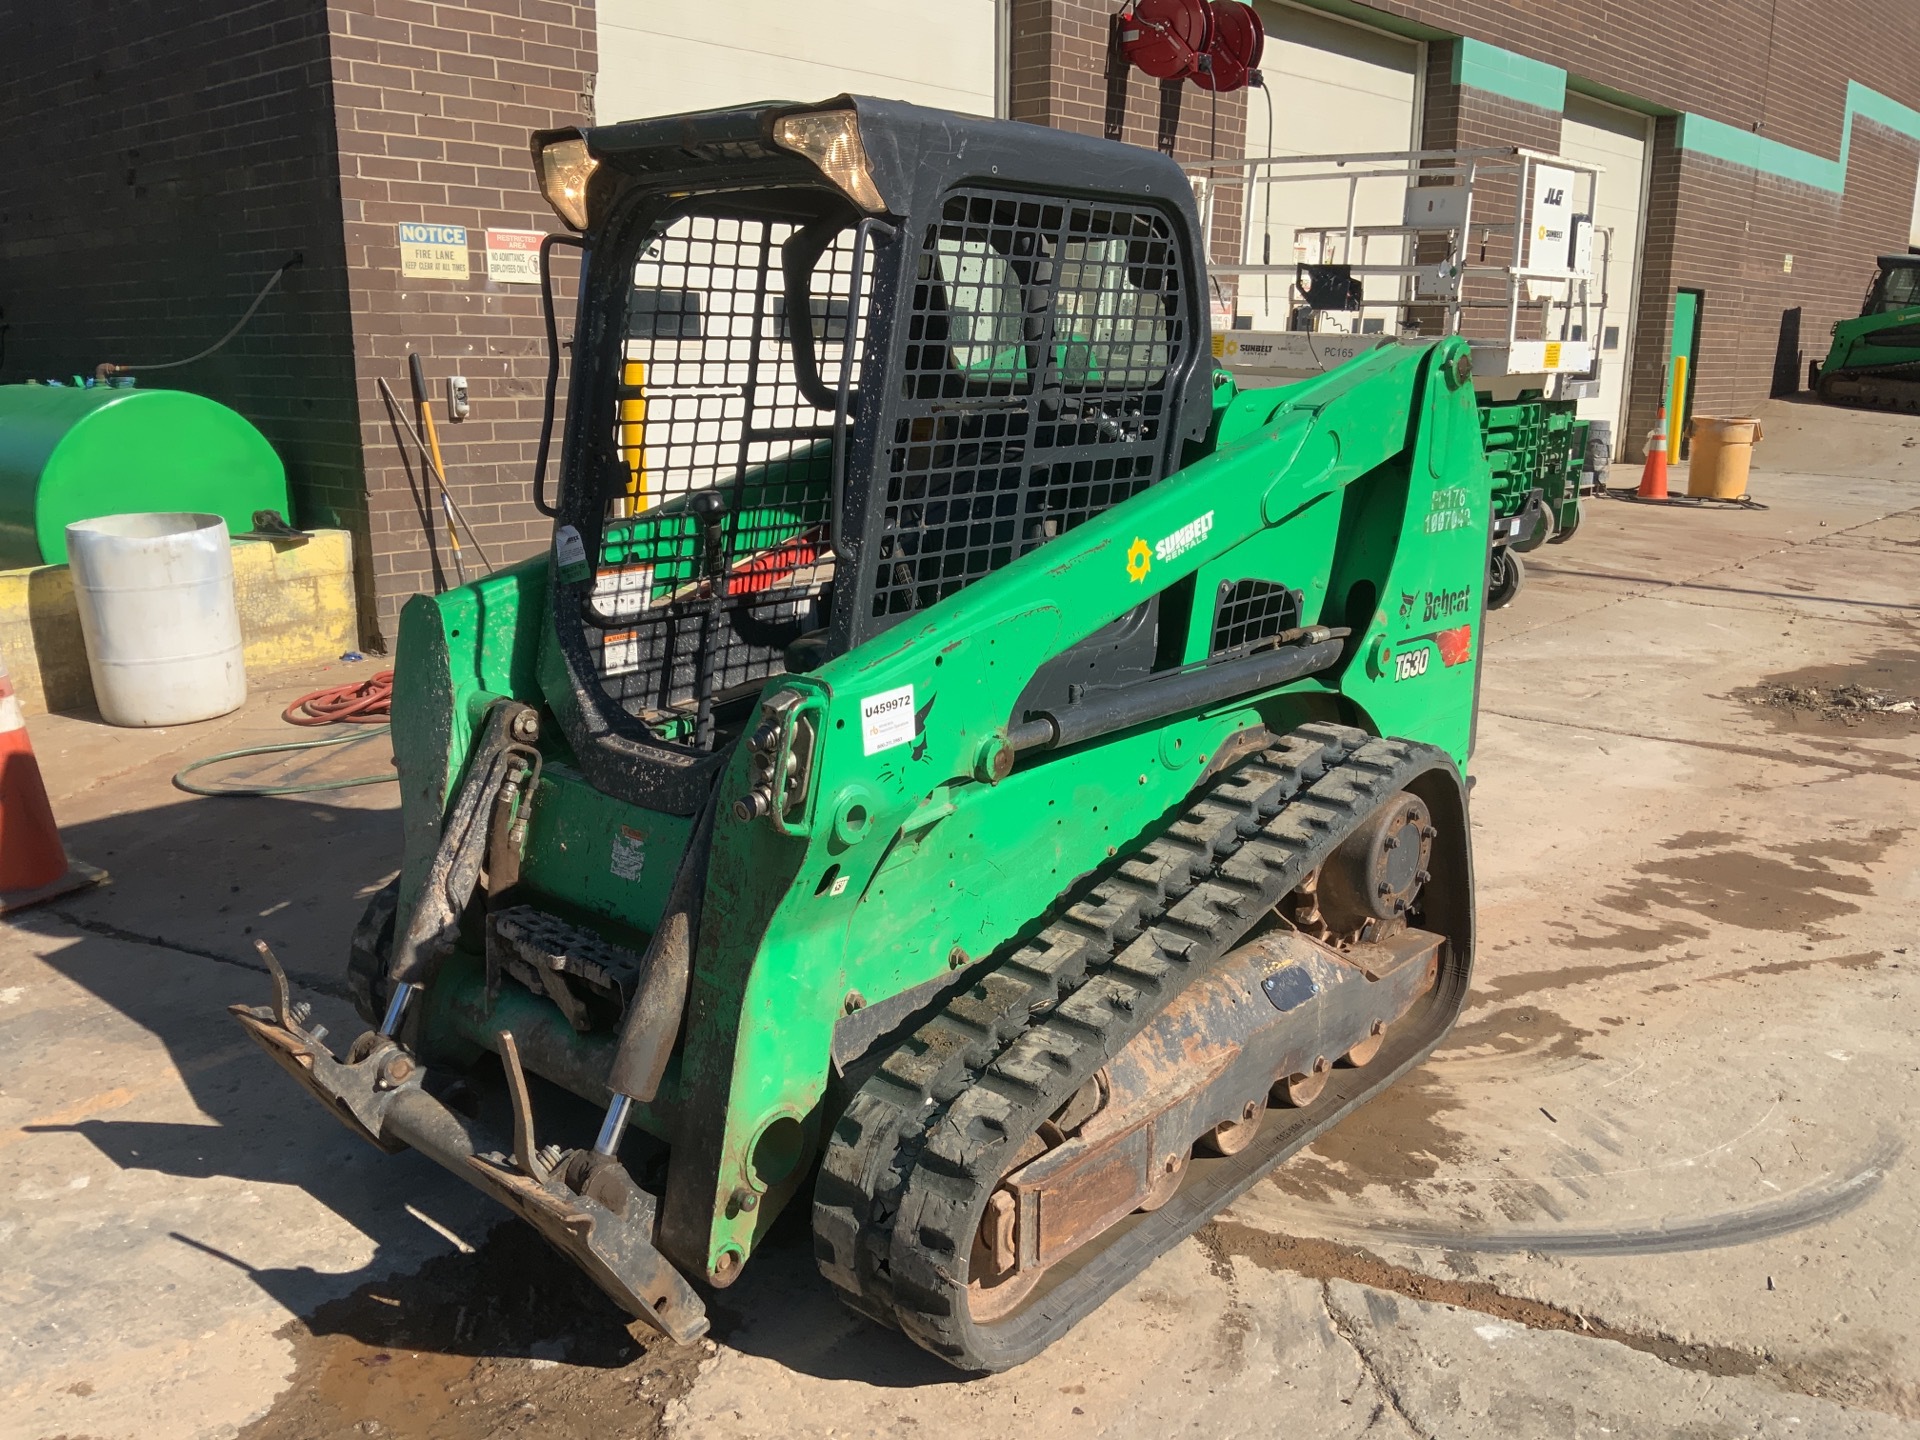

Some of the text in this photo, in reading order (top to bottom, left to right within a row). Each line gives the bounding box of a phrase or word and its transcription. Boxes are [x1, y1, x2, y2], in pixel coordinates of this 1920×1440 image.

[1543, 188, 1564, 206] JLG
[402, 225, 465, 244] NOTICE
[496, 234, 537, 244] RESTRICTED
[1545, 229, 1563, 239] SUNBELT
[415, 249, 455, 261] FIRE LANE
[491, 253, 525, 263] NO ADMITTANCE
[405, 261, 466, 272] KEEP CLEAR AT ALL TIMES
[490, 264, 528, 274] EMPLOYEES ONLY
[1239, 344, 1273, 353] SUNBELT
[1324, 347, 1353, 358] PC165
[1155, 509, 1215, 561] SUNBELT
[1165, 532, 1208, 563] RENTALS
[1423, 584, 1470, 622] Bobcat
[1395, 646, 1430, 683] T630
[865, 695, 911, 718] U459972
